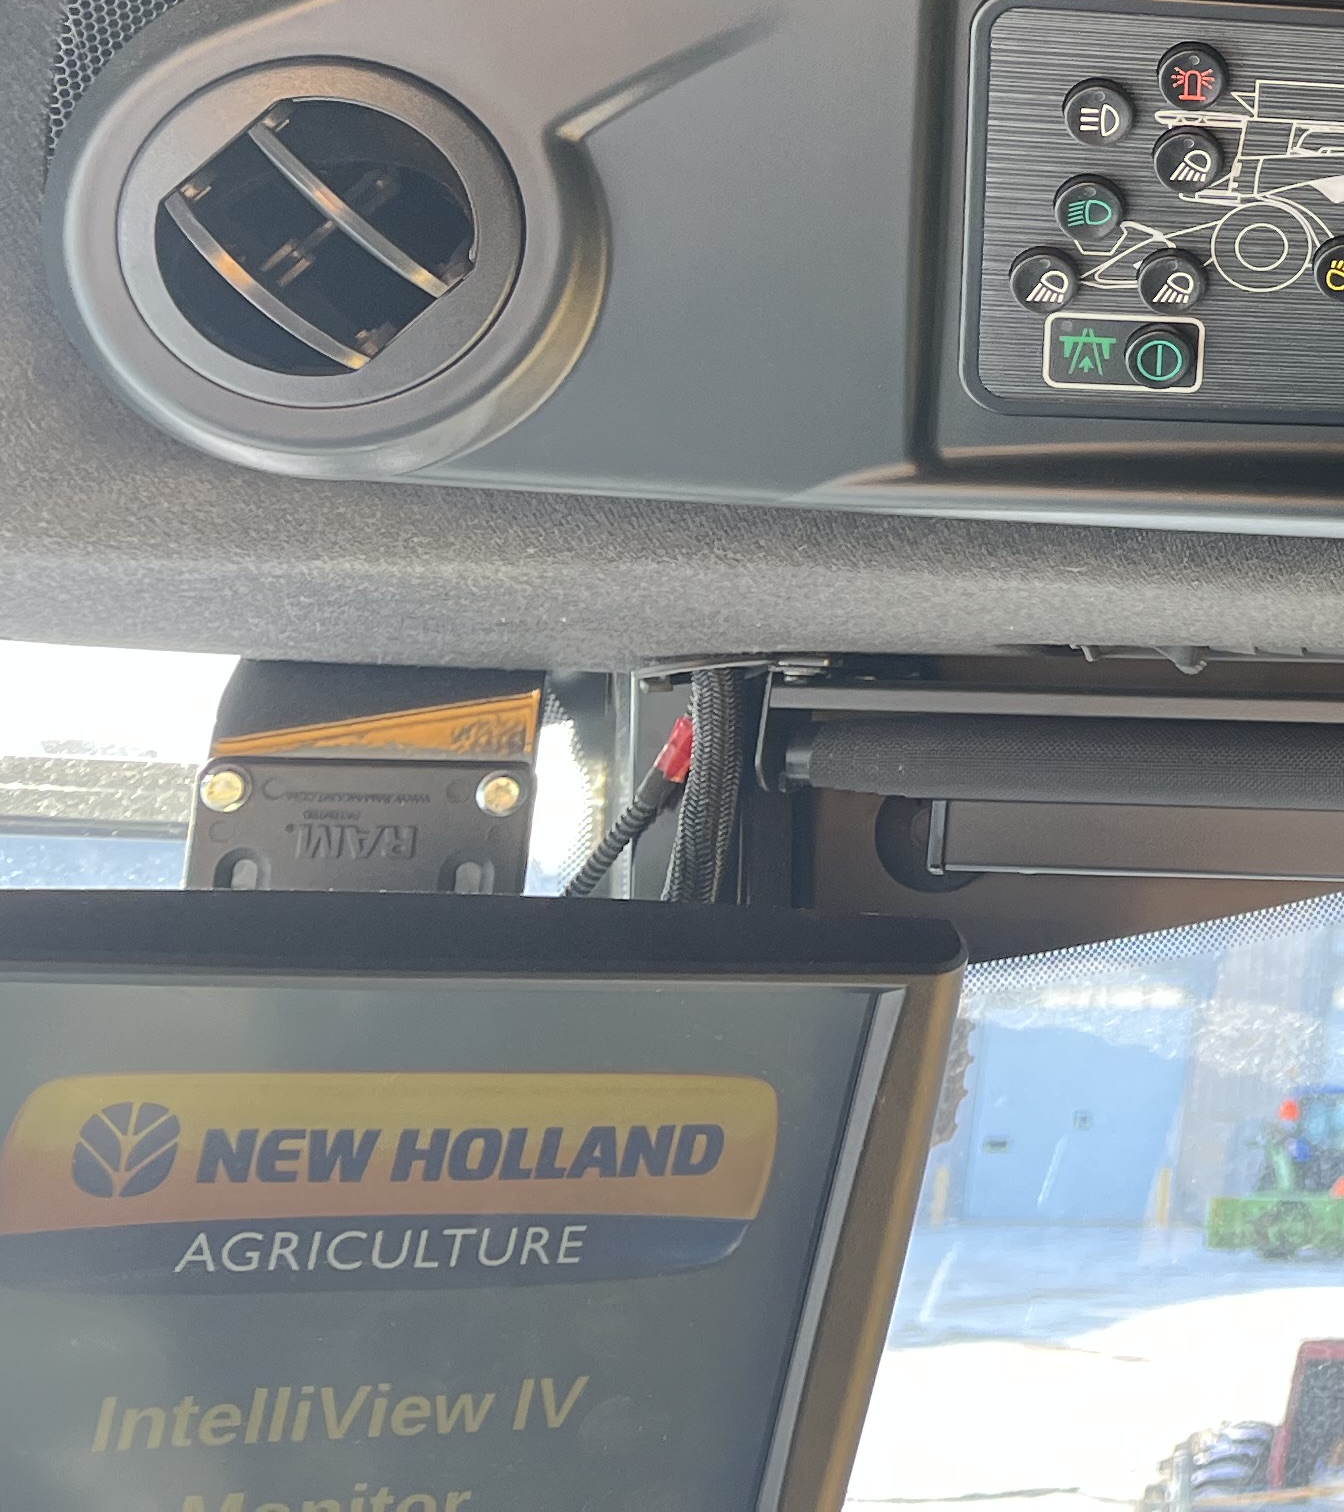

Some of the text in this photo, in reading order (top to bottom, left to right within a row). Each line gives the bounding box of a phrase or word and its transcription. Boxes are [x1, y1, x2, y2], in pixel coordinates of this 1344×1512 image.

[196, 1123, 725, 1184] NEW HOLLAND
[174, 1224, 588, 1273] AGRICULTURE
[91, 1375, 590, 1453] IntelliView IV
